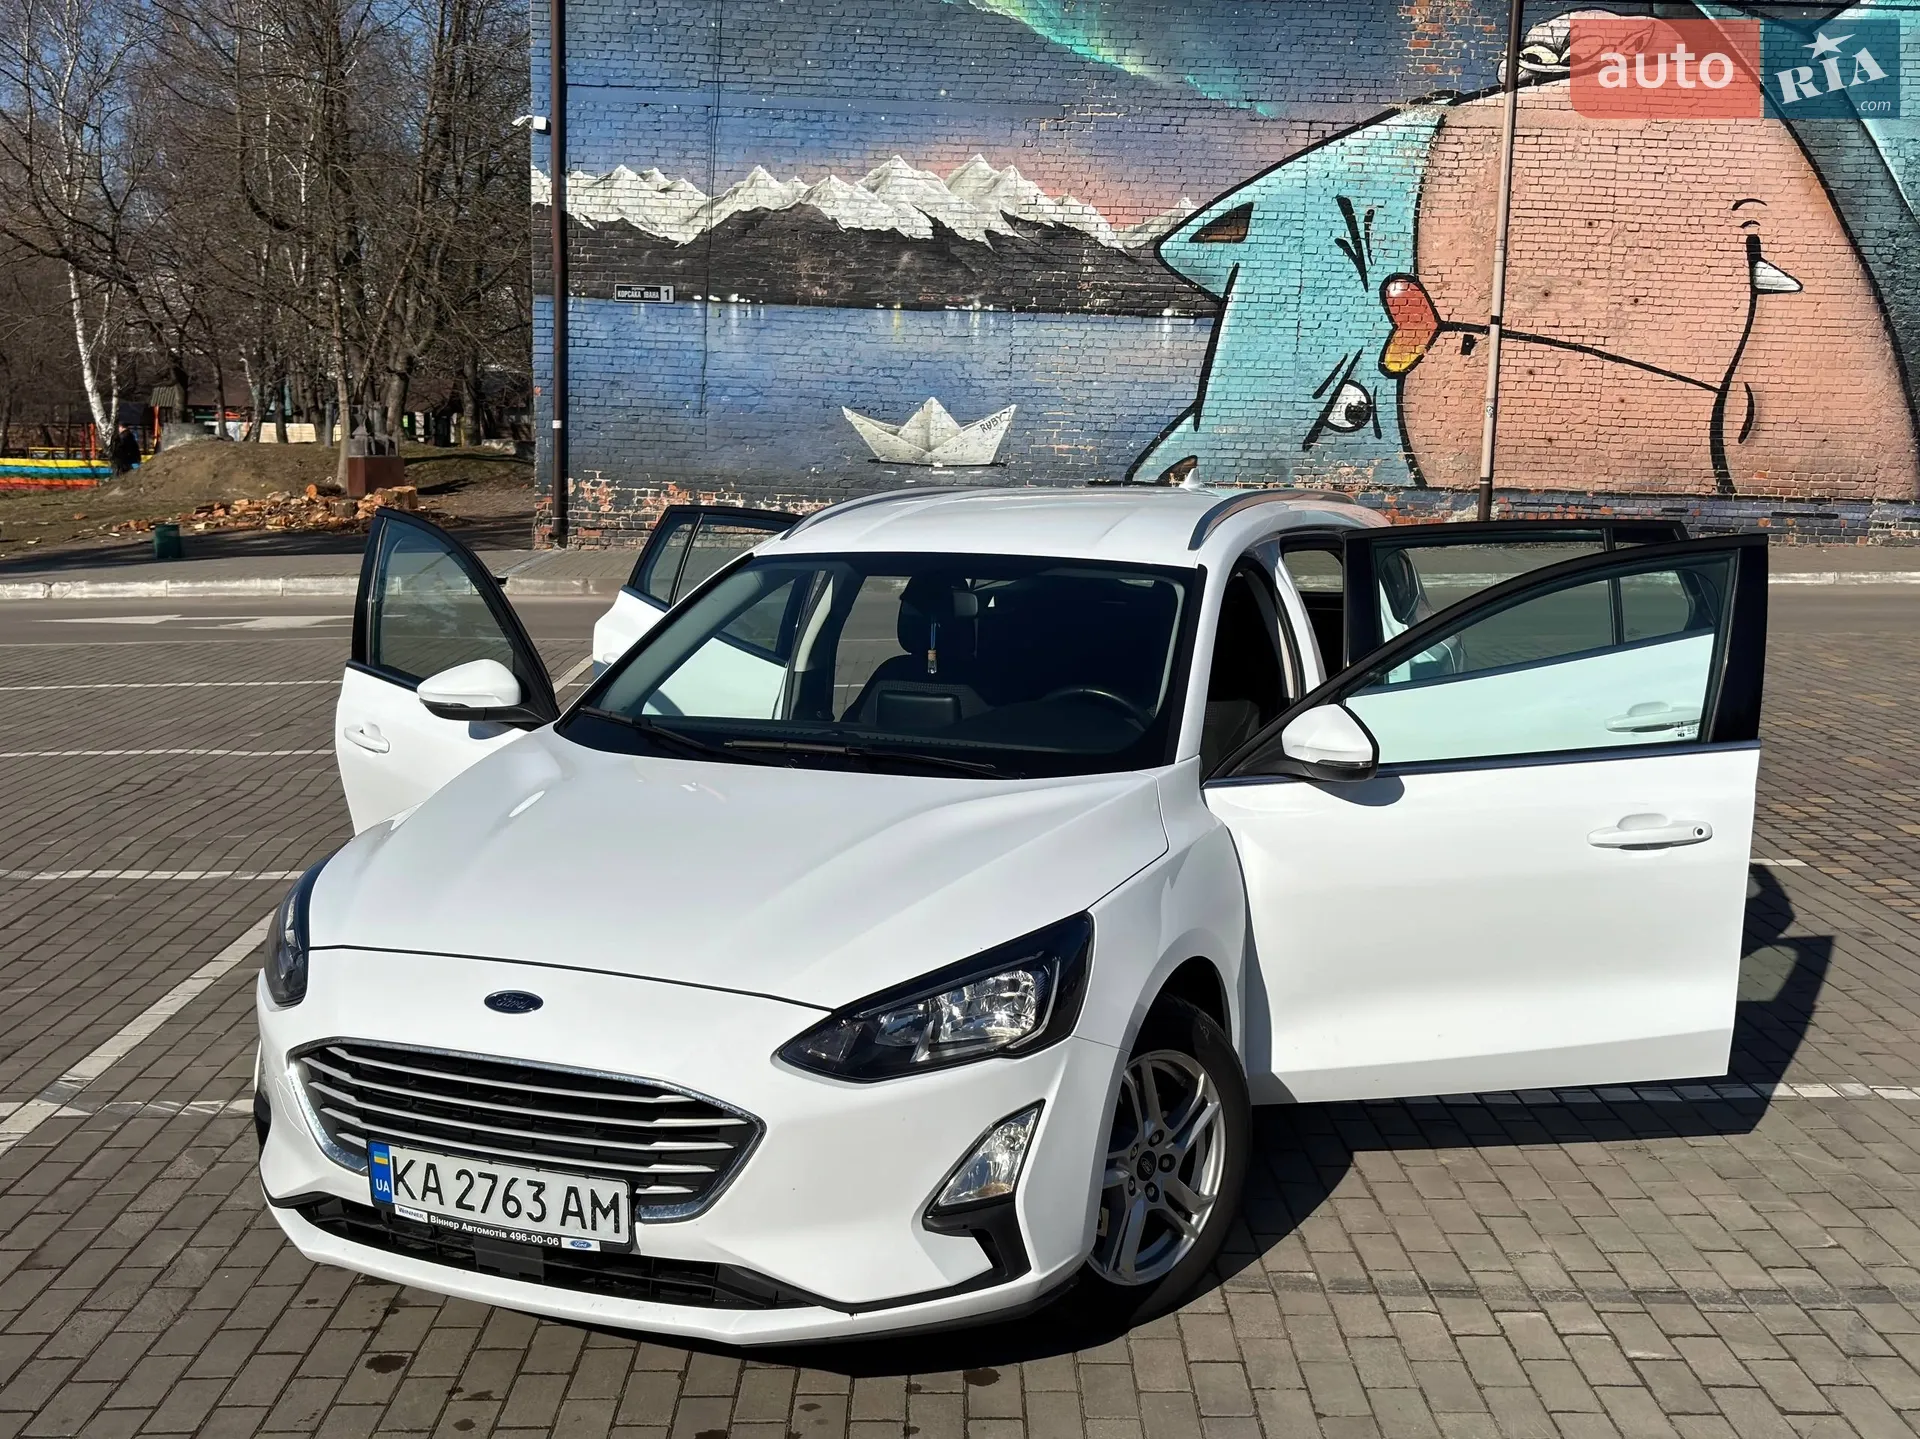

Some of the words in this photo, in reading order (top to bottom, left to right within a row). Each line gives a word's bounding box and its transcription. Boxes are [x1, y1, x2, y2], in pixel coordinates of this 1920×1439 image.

[664, 288, 670, 300] 1
[376, 1178, 390, 1193] UA
[392, 1155, 444, 1206] KA
[455, 1169, 547, 1223] 2763
[559, 1186, 620, 1233] AM
[430, 1215, 459, 1229] Віннер
[461, 1223, 507, 1238] Автомотів
[509, 1232, 559, 1245] 496-00-06
